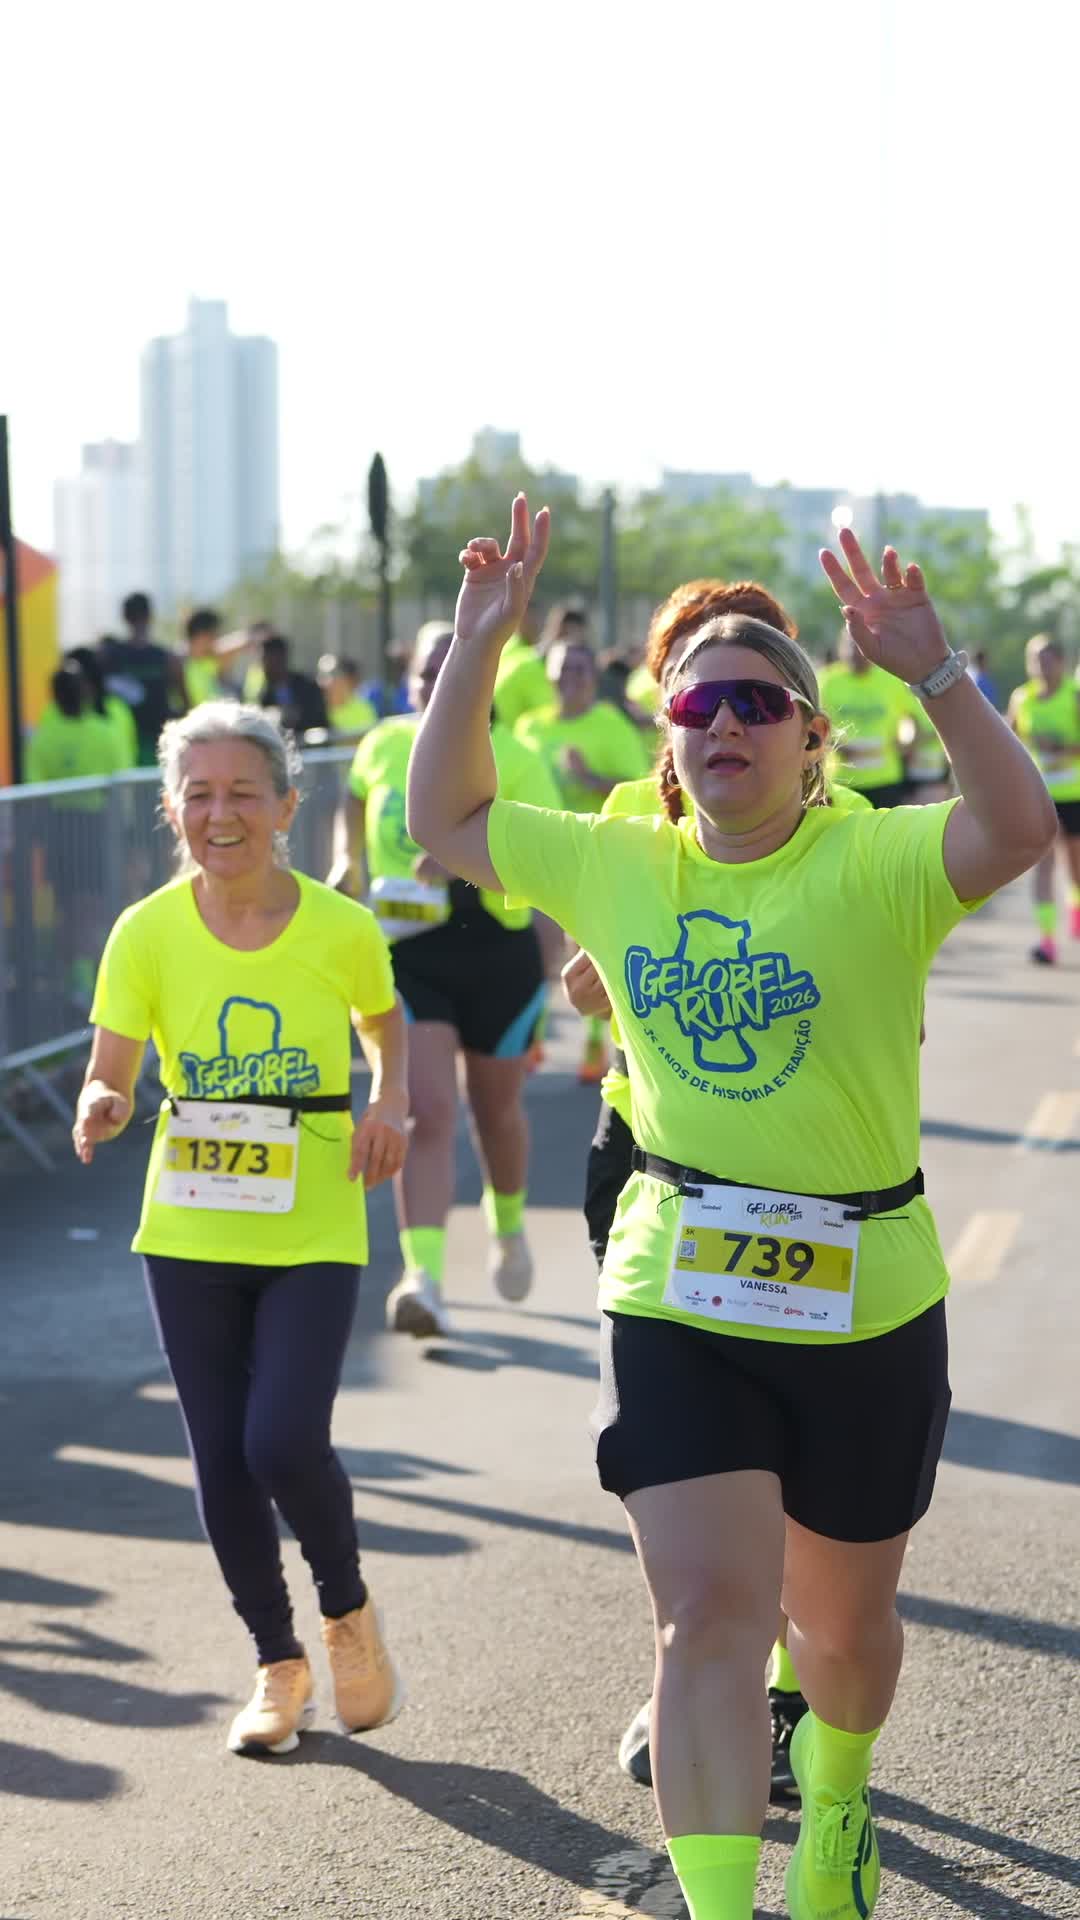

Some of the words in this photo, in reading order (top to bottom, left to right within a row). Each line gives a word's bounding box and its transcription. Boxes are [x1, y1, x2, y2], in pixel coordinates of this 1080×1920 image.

[640, 957, 807, 1002] GELOBEL
[673, 988, 764, 1037] RUN
[770, 989, 815, 1014] 2026
[197, 1050, 316, 1090] GELOBEL
[658, 1046, 690, 1080] ANOS
[690, 1076, 710, 1092] DE
[712, 1084, 776, 1102] HISTÓRIA
[772, 1075, 786, 1088] E
[780, 1019, 811, 1079] TRADIÇÃO
[188, 1140, 269, 1175] 1373
[747, 1202, 802, 1216] GELOBEL
[724, 1232, 814, 1282] 739
[740, 1280, 788, 1295] VANESSA
